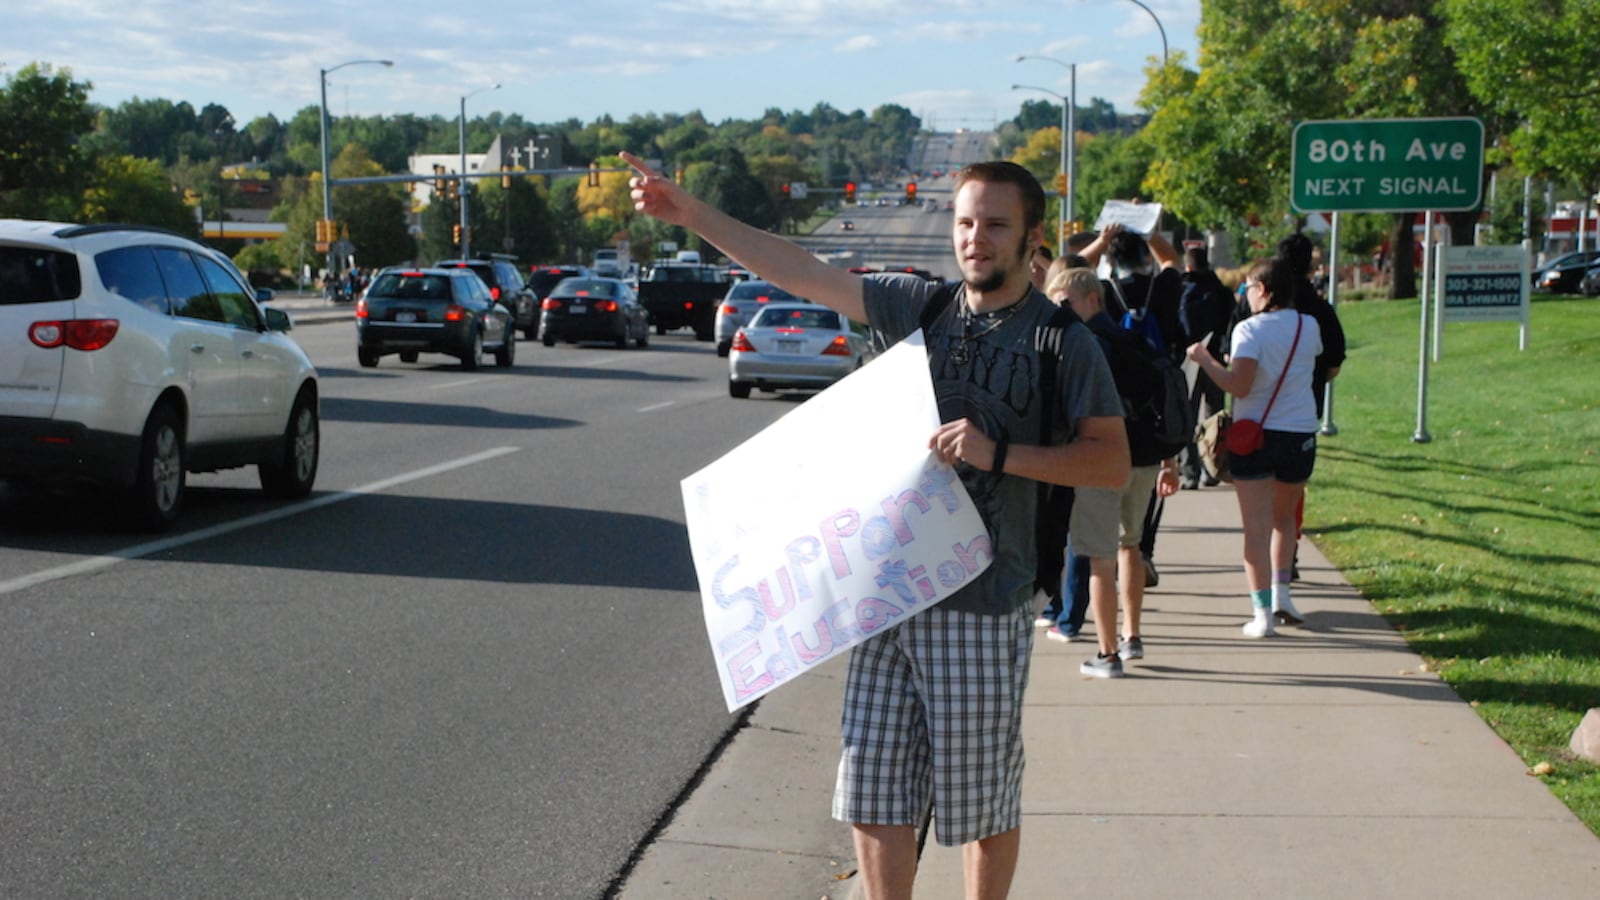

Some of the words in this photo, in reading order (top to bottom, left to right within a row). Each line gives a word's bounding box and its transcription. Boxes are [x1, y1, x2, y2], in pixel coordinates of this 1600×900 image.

[1308, 139, 1386, 163] 80th
[1405, 138, 1467, 161] Ave
[1305, 178, 1366, 196] NEXT
[1379, 177, 1467, 195] SIGNAL
[1446, 295, 1464, 305] IRA
[726, 534, 993, 703] Education
